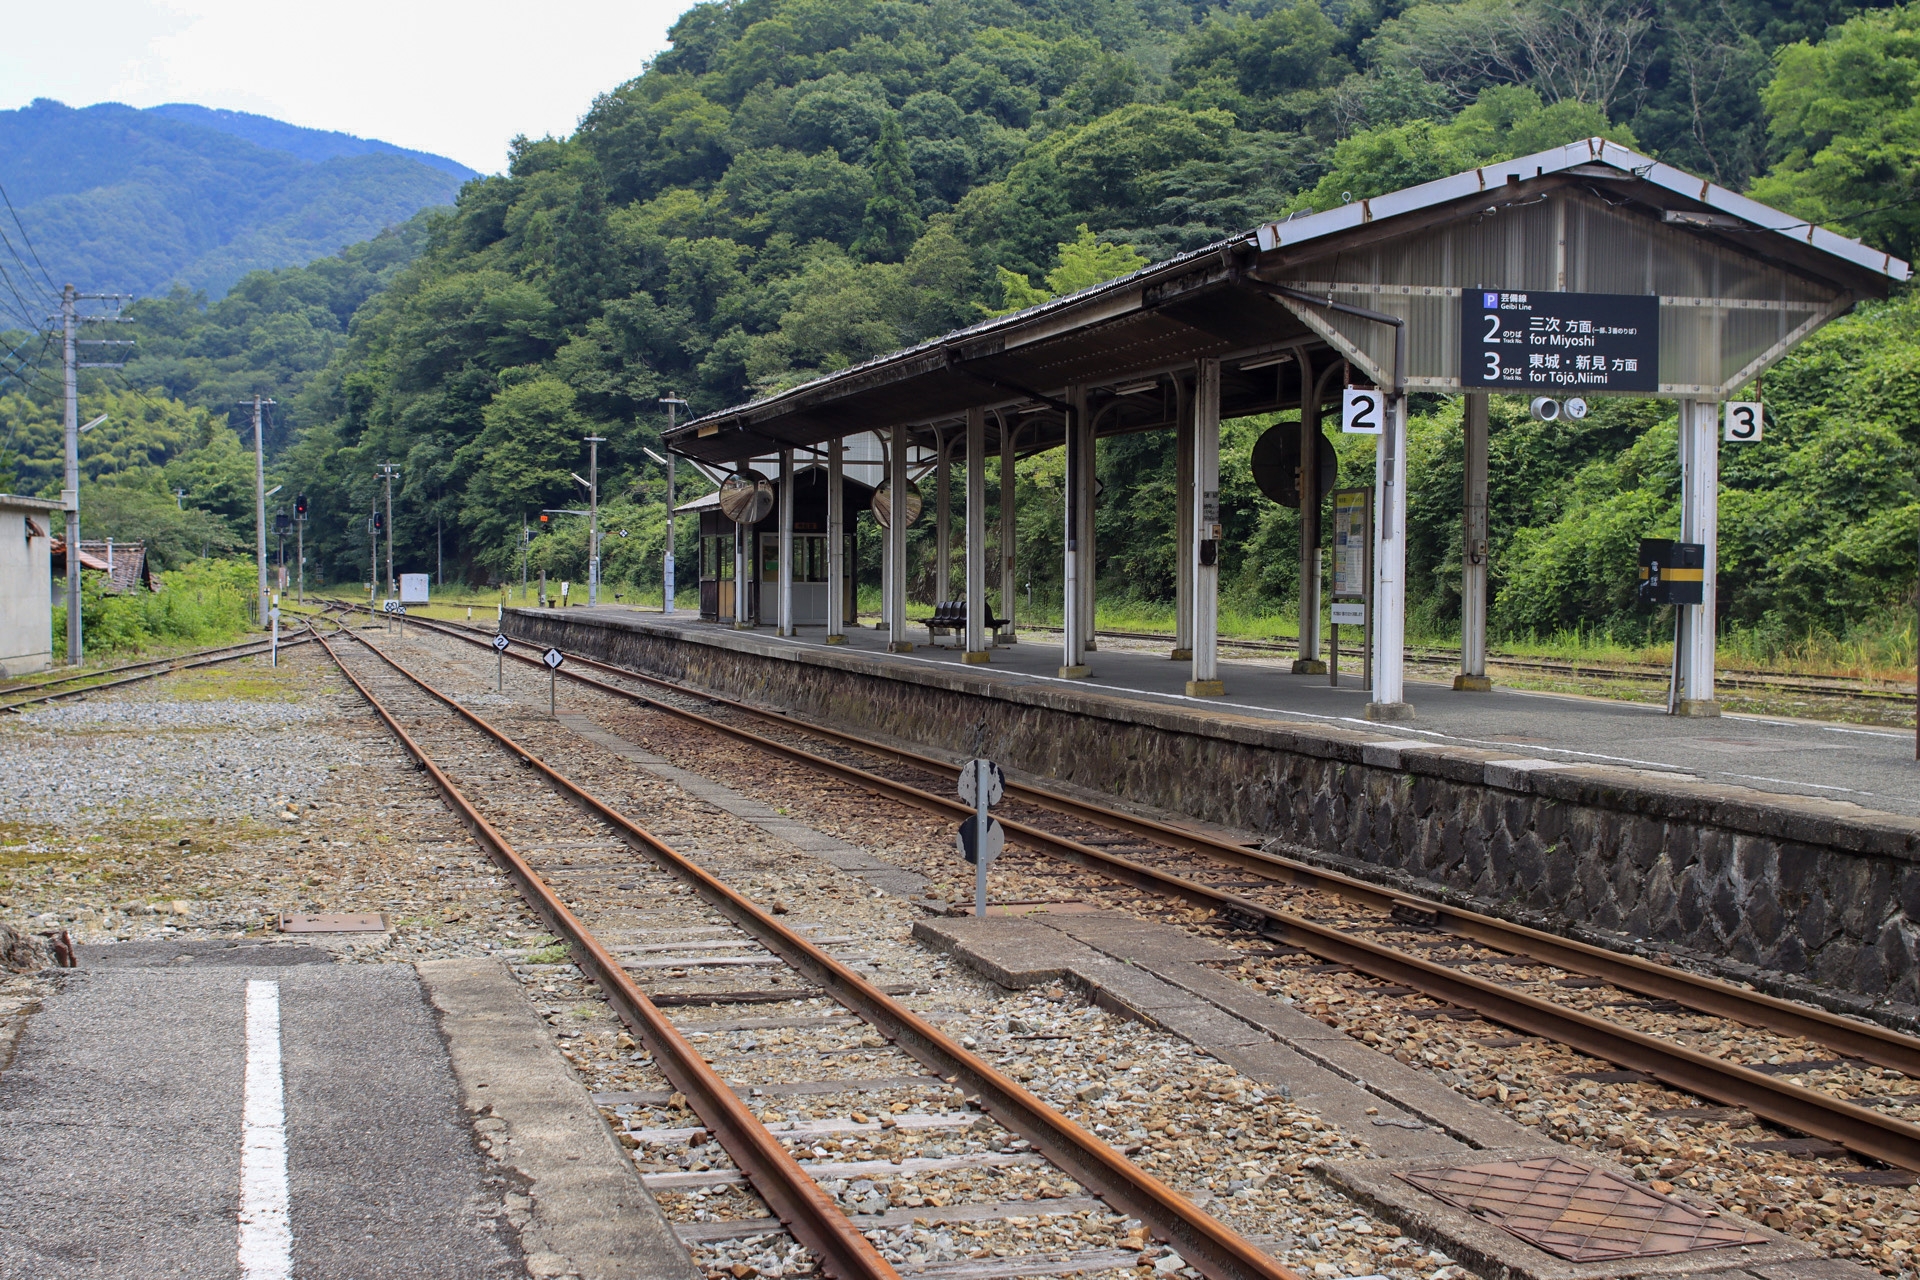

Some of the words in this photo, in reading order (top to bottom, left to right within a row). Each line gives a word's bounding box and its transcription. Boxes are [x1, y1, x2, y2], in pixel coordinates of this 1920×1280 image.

[1487, 294, 1496, 307] P
[1500, 293, 1527, 303] 芸備線
[1483, 314, 1501, 343] 2
[1529, 316, 1560, 332] 三次
[1565, 319, 1592, 334] 方面
[1502, 330, 1522, 338] のりば
[1529, 333, 1547, 345] for
[1550, 334, 1595, 348] Miyoshi
[1483, 351, 1501, 380] 3
[1529, 353, 1606, 371] 東城・新見
[1611, 358, 1638, 372] 方面
[1502, 367, 1522, 375] のりば
[1529, 370, 1547, 382] for
[1549, 371, 1608, 386] Tōjō,Niimi
[1351, 395, 1376, 428] 2
[1731, 406, 1756, 439] 3
[497, 638, 504, 646] 2
